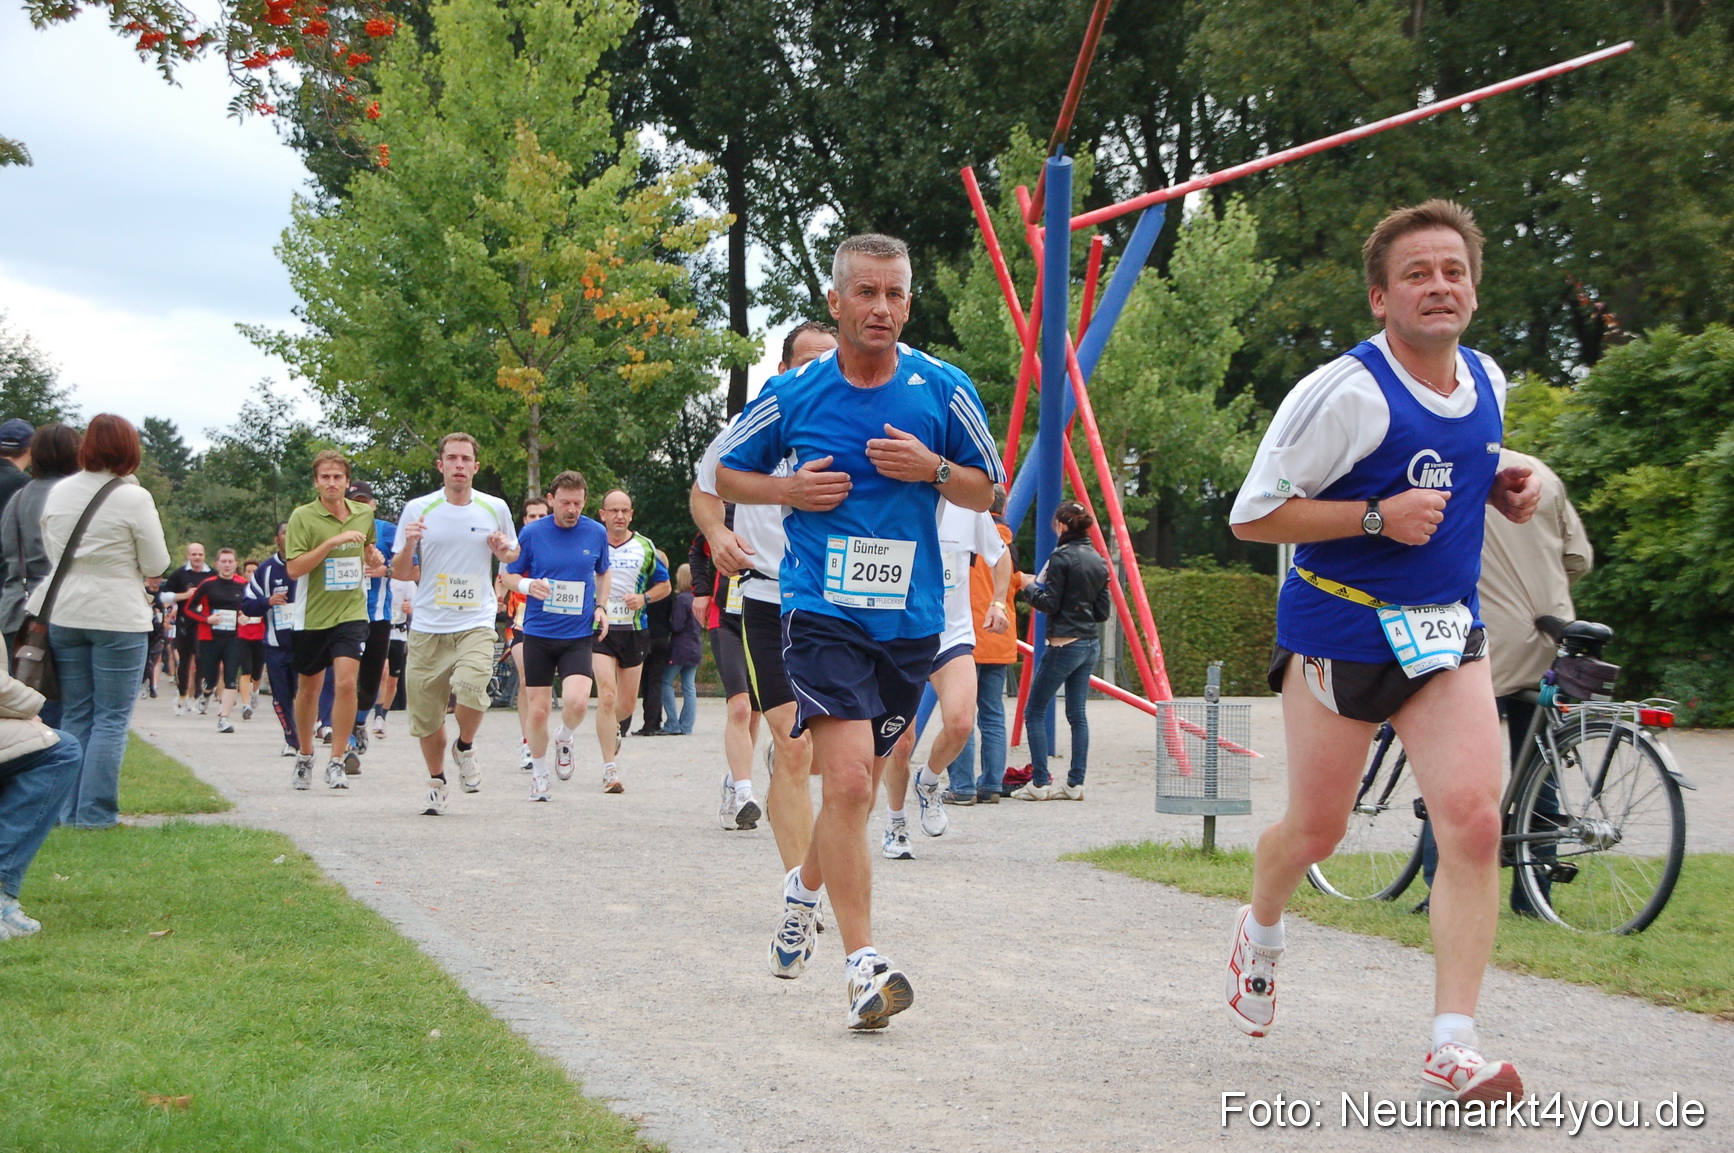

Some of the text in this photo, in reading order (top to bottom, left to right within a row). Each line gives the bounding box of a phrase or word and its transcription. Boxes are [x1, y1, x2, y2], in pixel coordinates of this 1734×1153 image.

[853, 539, 889, 555] Günter
[831, 558, 838, 568] B
[338, 569, 359, 579] 3430
[851, 562, 902, 583] 2059
[449, 577, 469, 585] Volker
[453, 589, 475, 599] 445
[556, 593, 579, 603] 2891
[612, 606, 630, 615] 410
[1394, 627, 1402, 637] A
